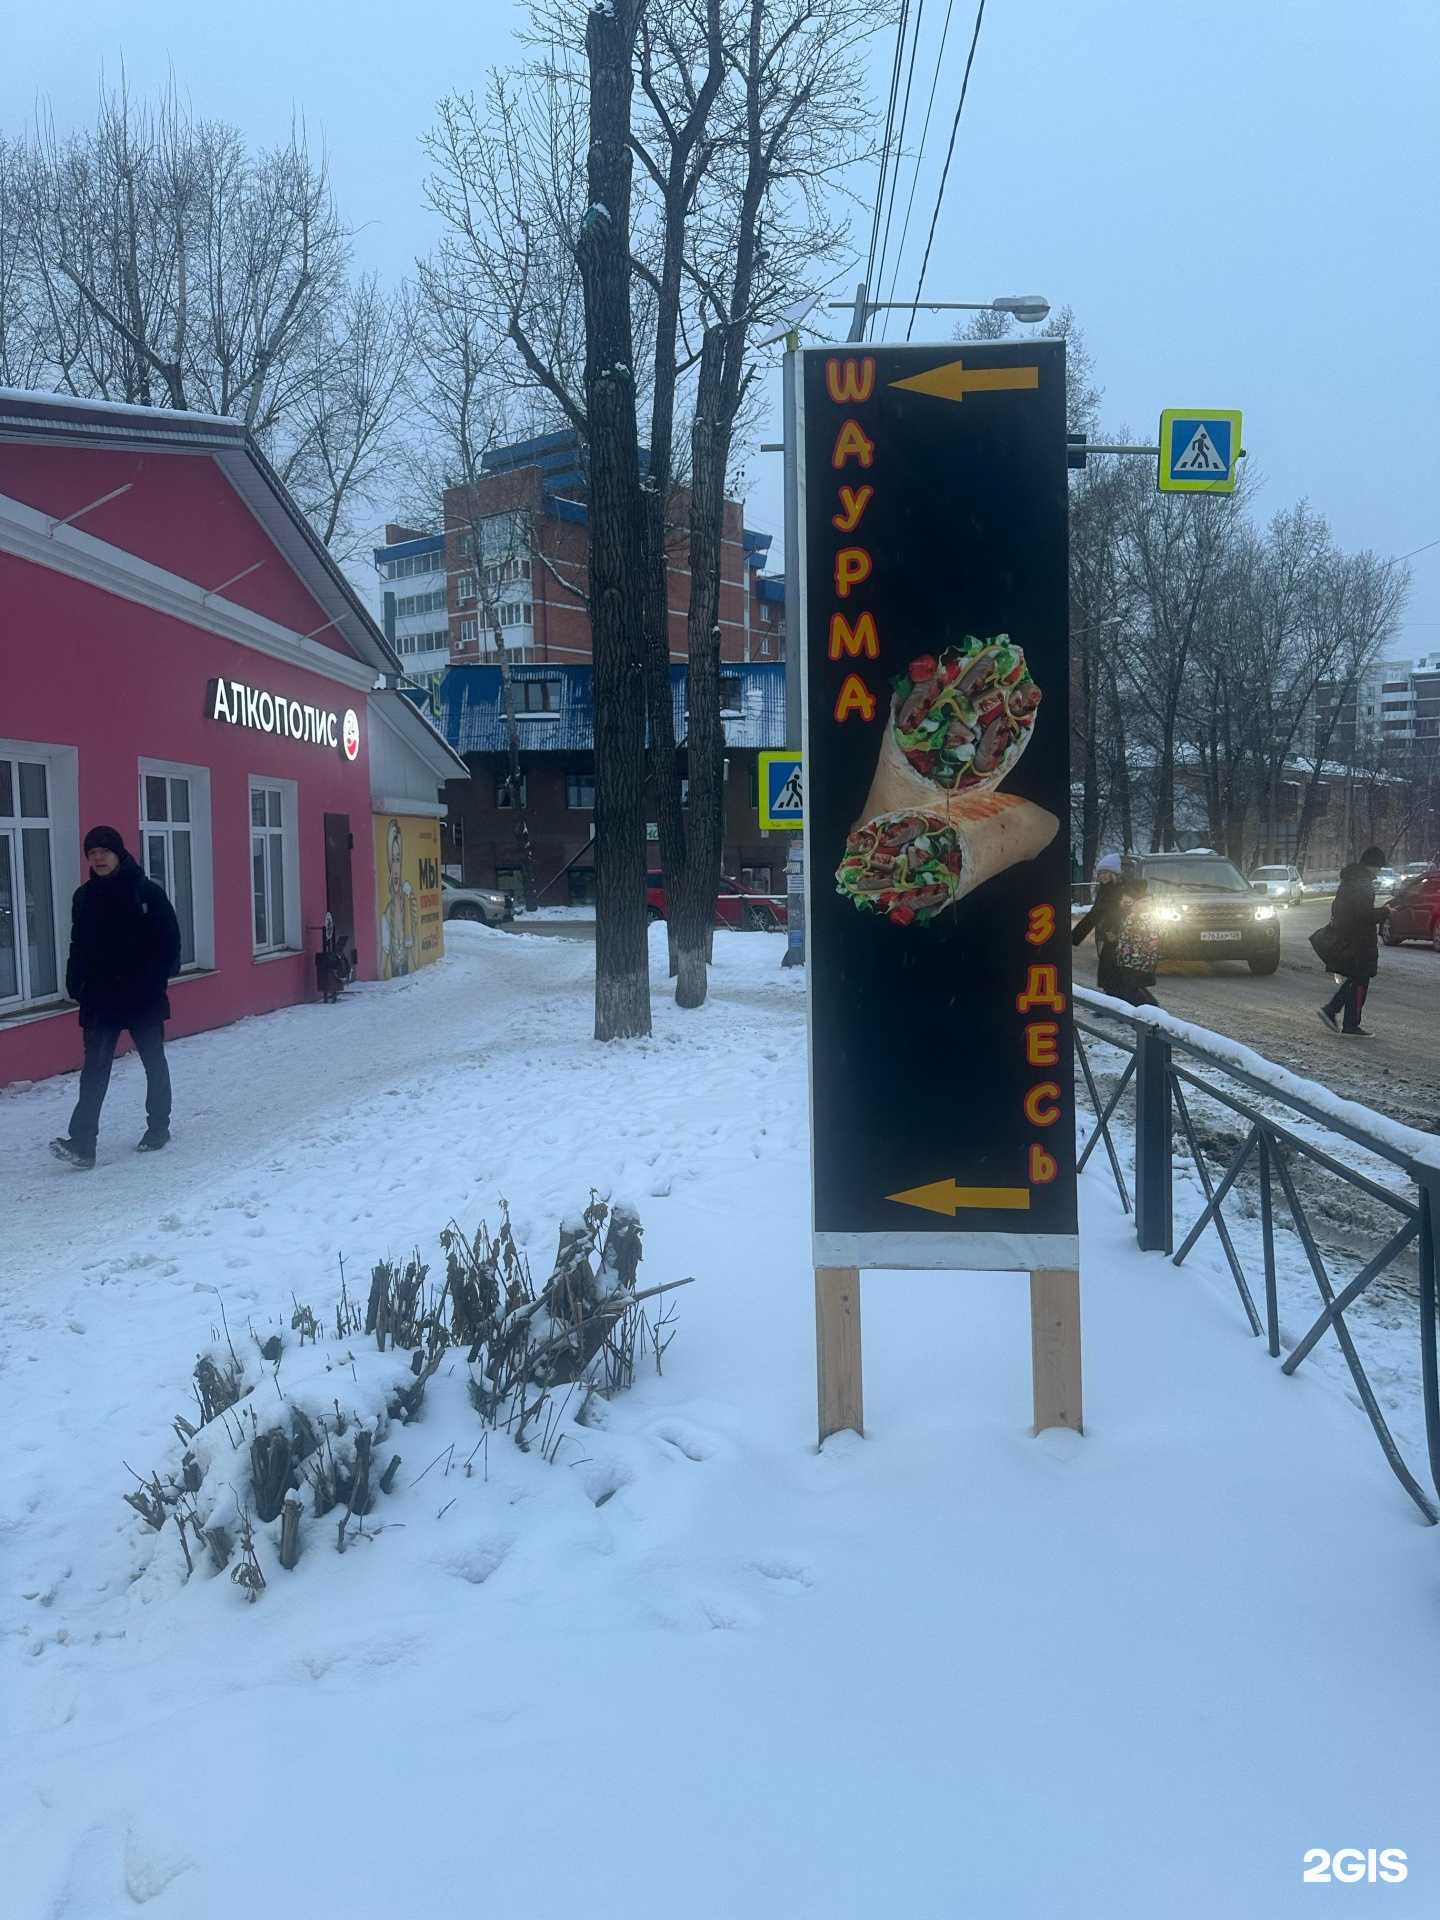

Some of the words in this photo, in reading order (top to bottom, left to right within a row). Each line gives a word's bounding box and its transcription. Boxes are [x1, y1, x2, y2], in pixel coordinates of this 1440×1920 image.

[826, 357, 880, 723] ШАУРМА
[214, 677, 338, 748] АЛКОПОЛИС
[418, 857, 439, 890] МЫ
[1016, 903, 1066, 1184] ЗДЕСЬ
